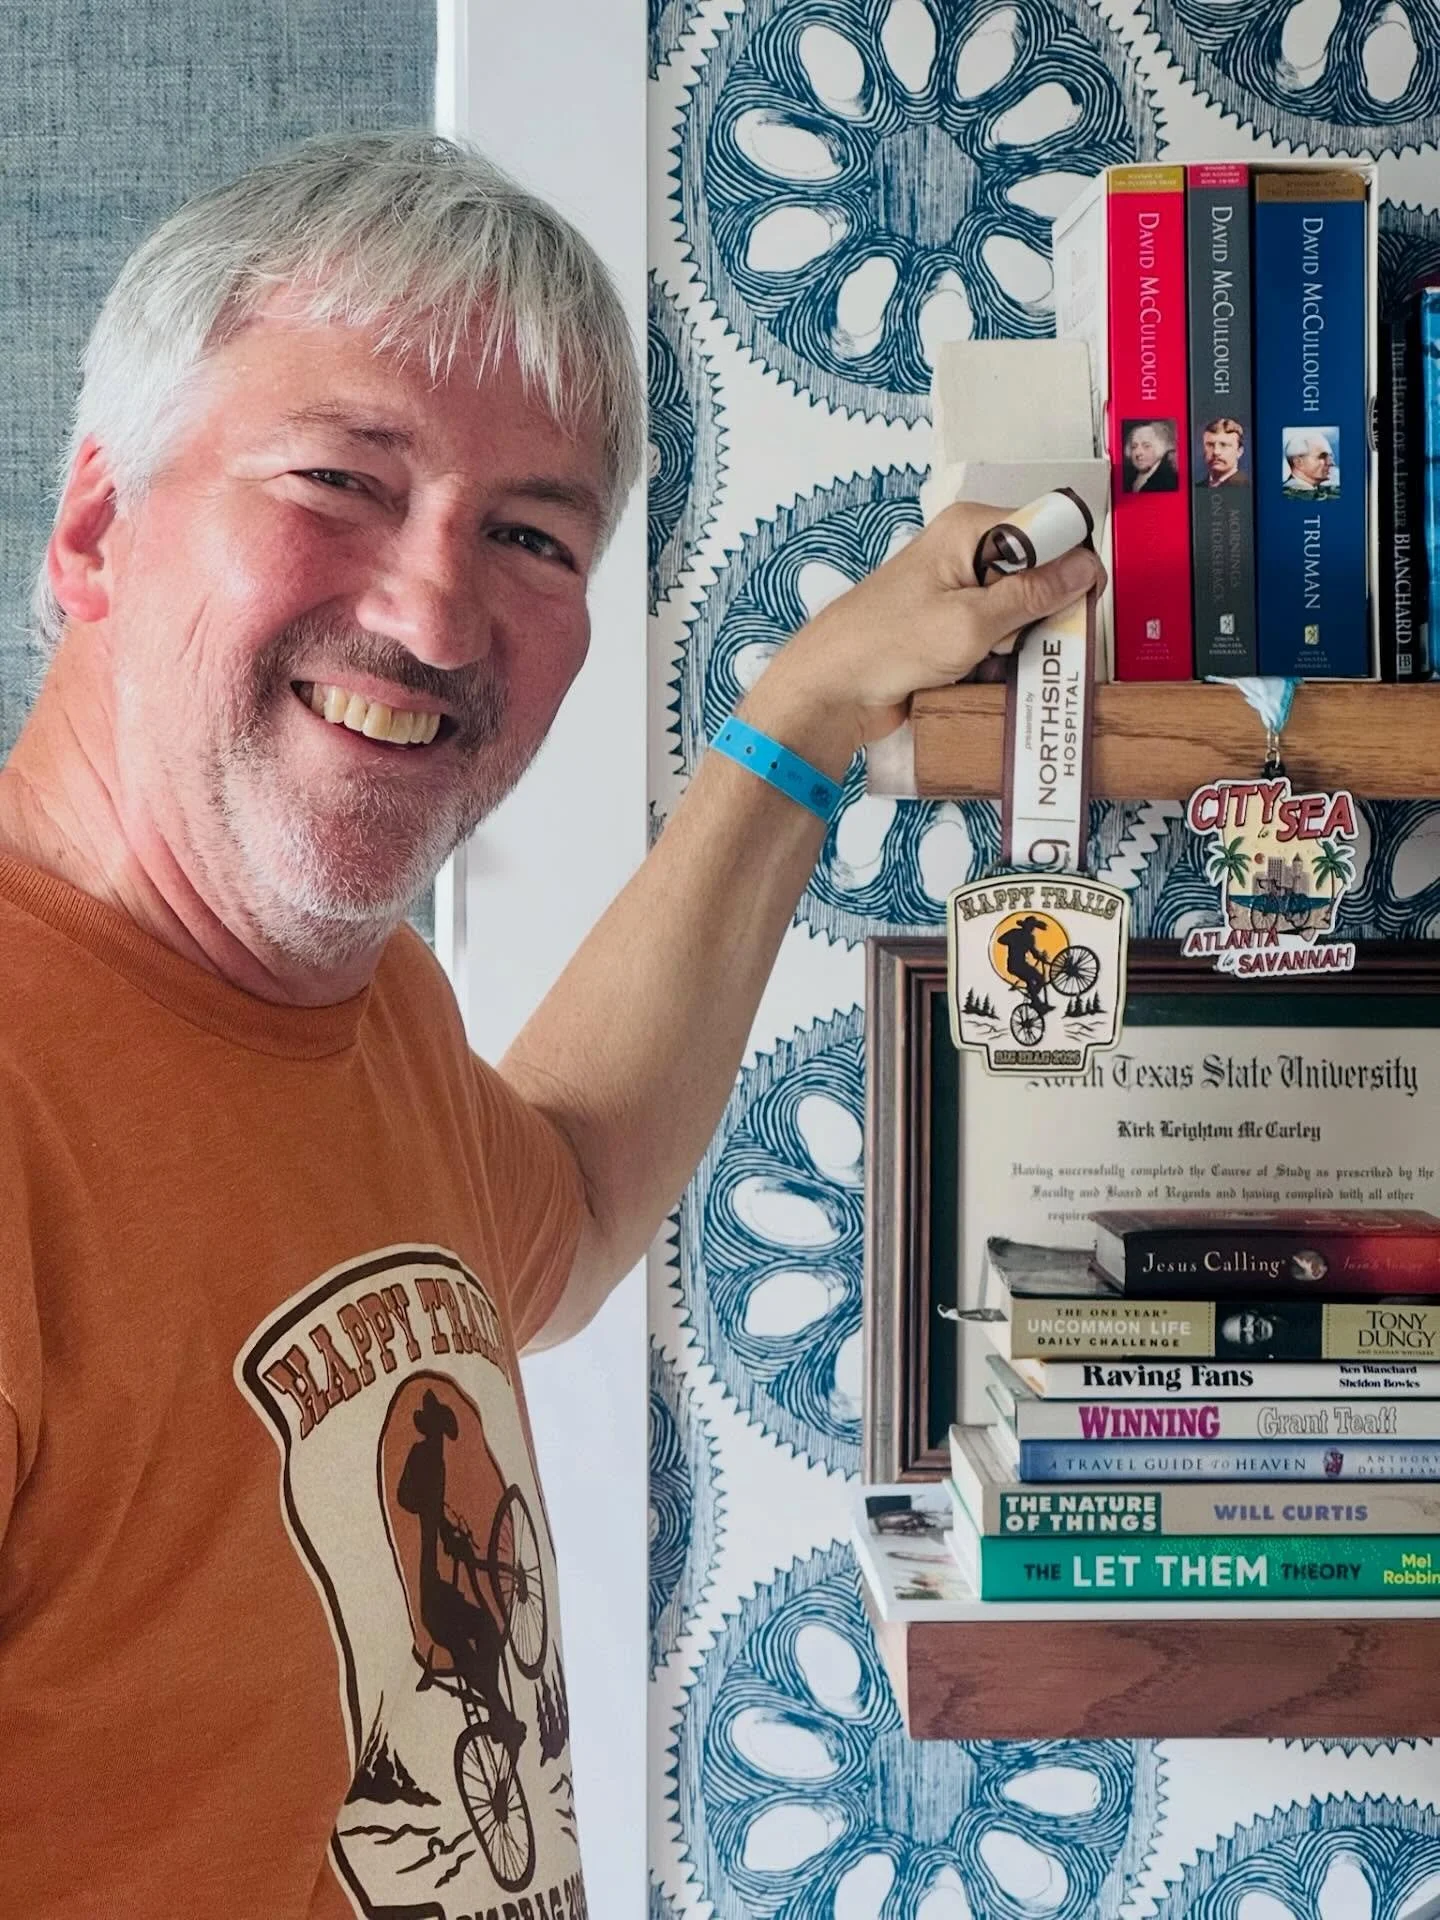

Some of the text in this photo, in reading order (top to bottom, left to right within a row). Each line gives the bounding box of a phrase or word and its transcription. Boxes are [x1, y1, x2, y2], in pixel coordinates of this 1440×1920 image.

[1138, 212, 1161, 269] DAVID
[1211, 205, 1233, 263] DAVID
[1302, 216, 1324, 275] DAVID
[1303, 515, 1321, 610] TRUMAN
[1394, 533, 1412, 645] BLANCHARD
[1039, 640, 1061, 806] NORTHSIDE
[1064, 672, 1079, 776] HOSPITAL
[1191, 782, 1285, 831] CITY
[1276, 795, 1355, 842] SEA
[958, 887, 1119, 921] HAPPY TRAILS
[1187, 927, 1280, 953] ATLANTA
[1238, 949, 1352, 974] SAVANNAH
[1112, 1053, 1195, 1092] Texas
[1200, 1052, 1271, 1089] State
[1279, 1054, 1419, 1096] University
[1117, 1119, 1156, 1139] Kirk
[1159, 1119, 1233, 1142] Leighton
[1010, 1162, 1054, 1180] Having
[1130, 1164, 1184, 1180] completed
[1188, 1164, 1206, 1180] the
[1210, 1162, 1251, 1178] Course
[1273, 1162, 1311, 1181] Study
[1398, 1165, 1413, 1182] by
[1079, 1186, 1100, 1199] and
[1216, 1187, 1237, 1200] and
[1242, 1187, 1280, 1203] having
[1142, 1252, 1198, 1275] Jesus
[1056, 1308, 1085, 1318] THE
[1089, 1308, 1118, 1318] ONE
[1366, 1310, 1428, 1331] TONY
[1027, 1319, 1191, 1337] UNCOMMON LIFE
[1358, 1329, 1437, 1349] DUNGY
[1037, 1337, 1181, 1347] DAILY CHALLENGE
[262, 1283, 422, 1440] HAPPY
[1340, 1365, 1418, 1375] Ken Blanchard
[1083, 1365, 1254, 1391] Raving Fans
[1339, 1378, 1421, 1389] Sheldon Bowles
[1078, 1405, 1398, 1439] WINNING Grant Teaff
[1067, 1457, 1136, 1471] TRAVEL
[1144, 1457, 1203, 1471] GUIDE
[1235, 1456, 1307, 1471] HEAVEN
[1006, 1496, 1157, 1512] THE NATURE
[1214, 1504, 1369, 1521] WILL CURTIS
[1005, 1515, 1157, 1532] OF THINGS
[1023, 1555, 1362, 1587] THE LET THEM THEORY
[1401, 1553, 1432, 1569] Mel
